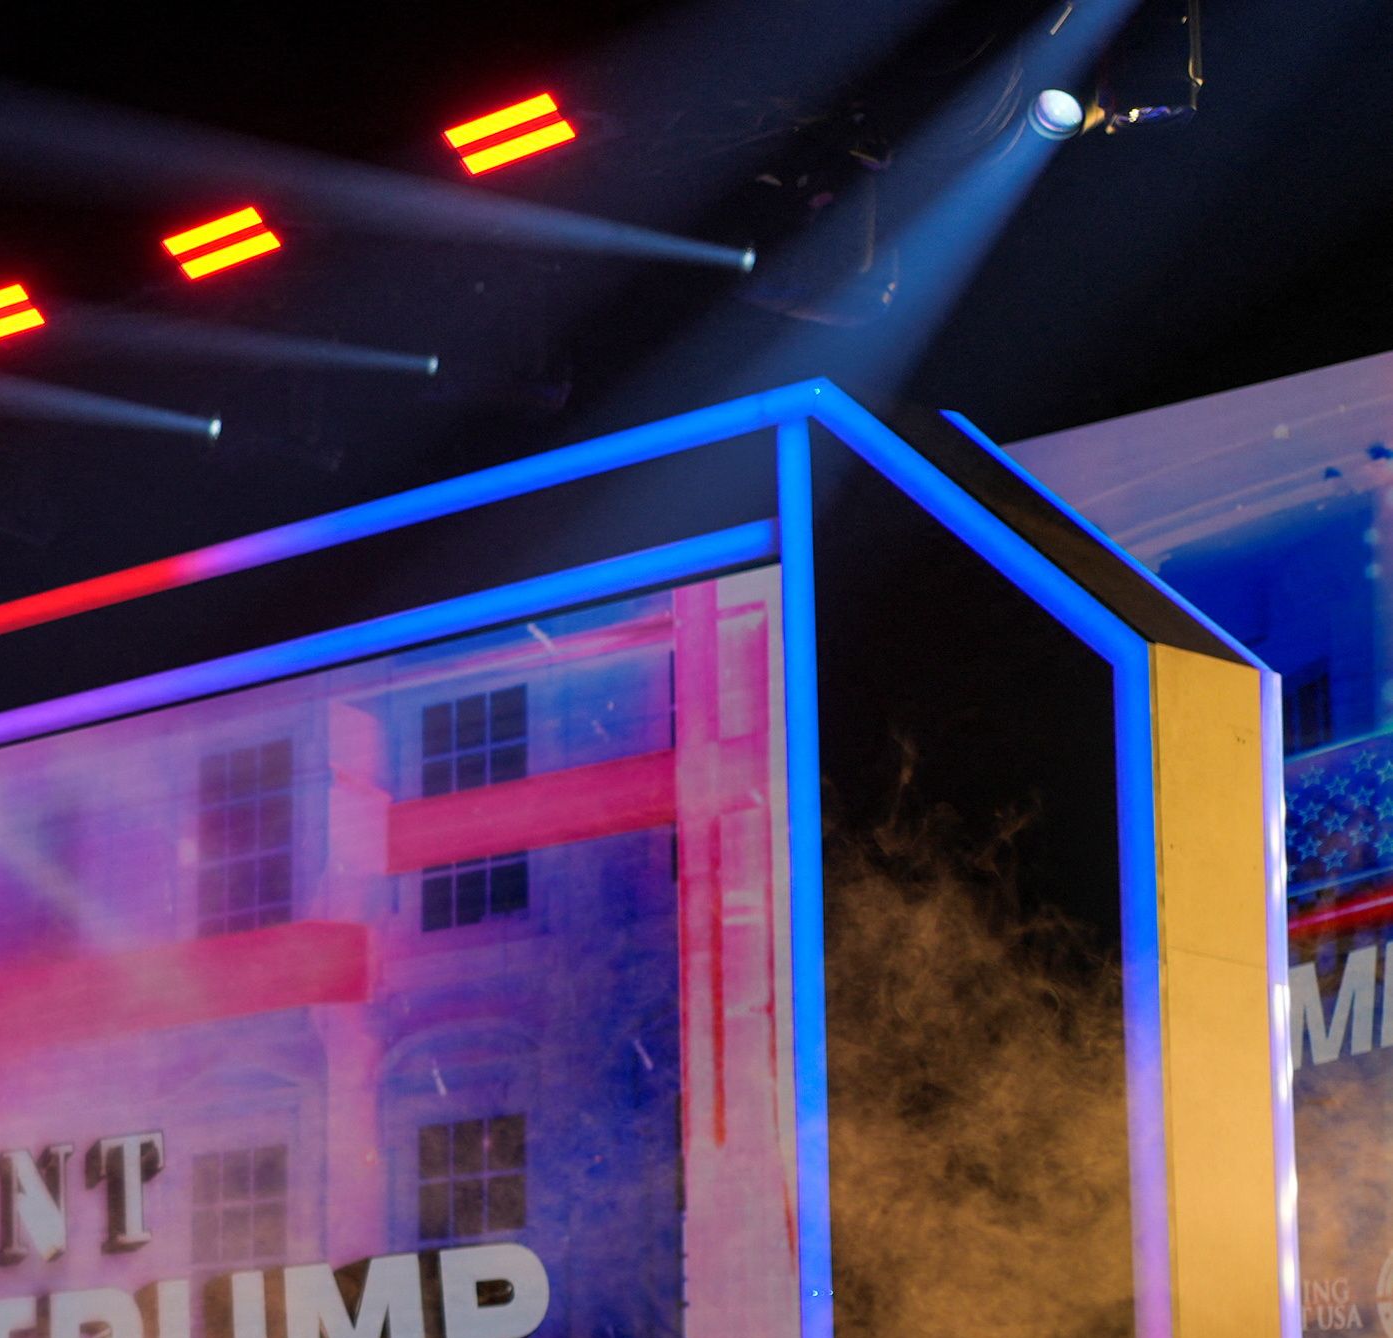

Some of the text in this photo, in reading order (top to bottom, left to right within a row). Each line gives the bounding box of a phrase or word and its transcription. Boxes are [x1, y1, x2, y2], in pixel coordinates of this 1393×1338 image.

[1289, 941, 1393, 1070] M
[1302, 1277, 1349, 1304] ING
[1317, 1303, 1363, 1330] USA
